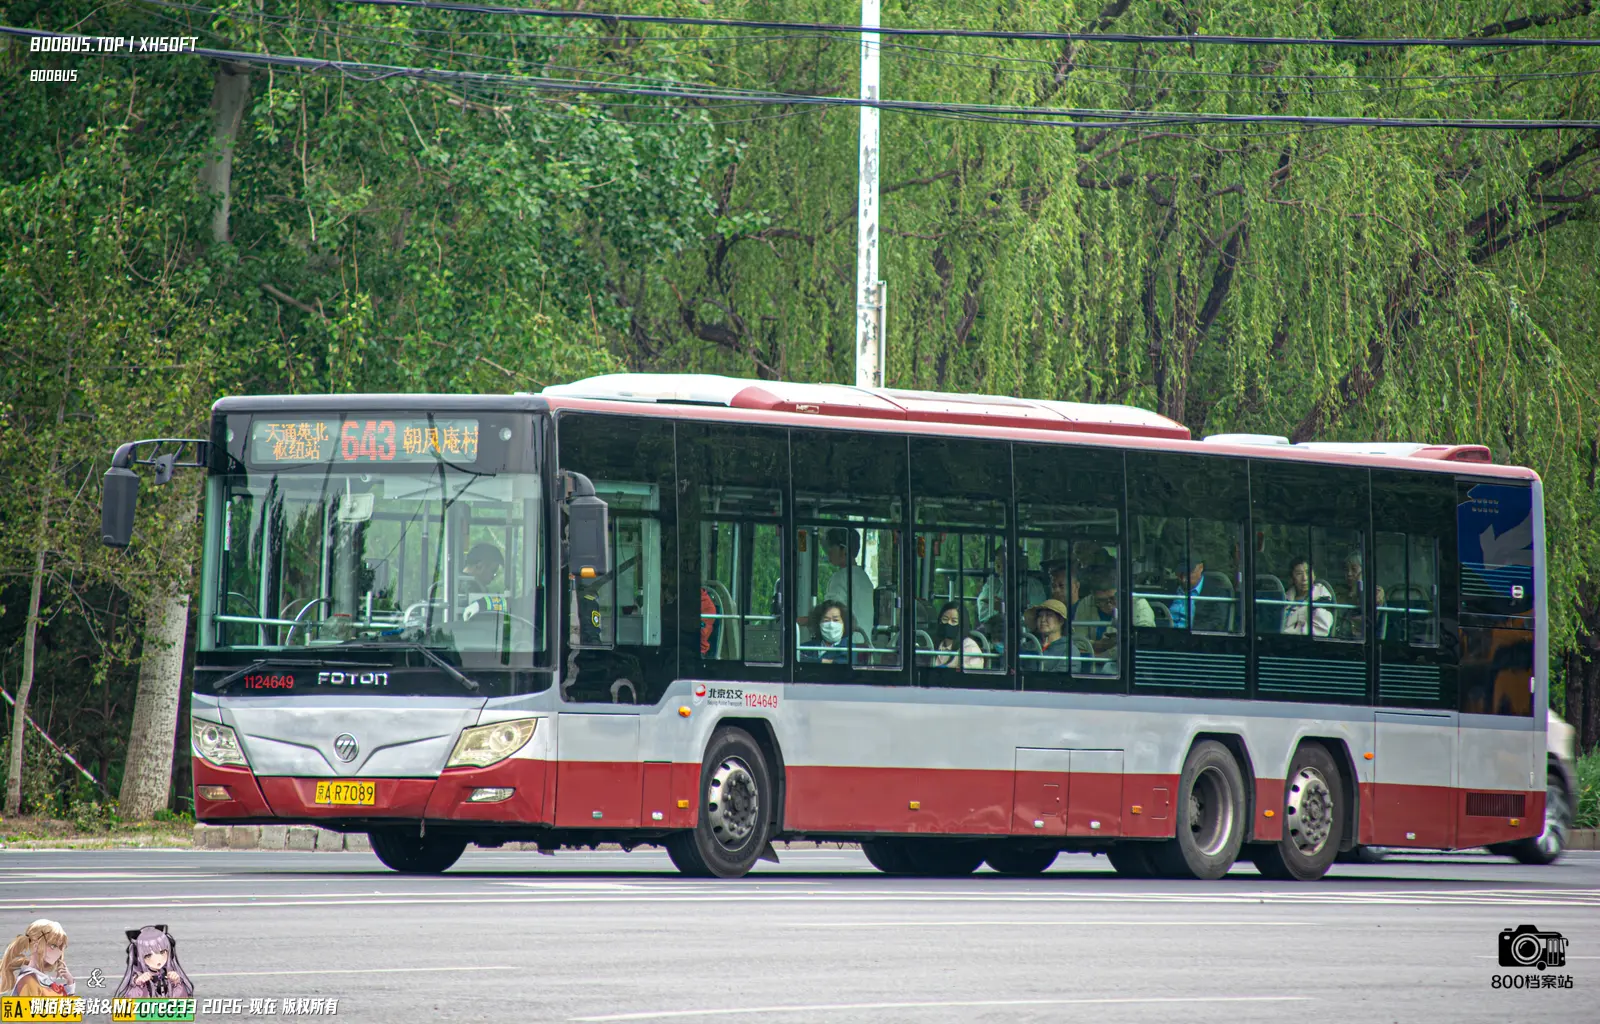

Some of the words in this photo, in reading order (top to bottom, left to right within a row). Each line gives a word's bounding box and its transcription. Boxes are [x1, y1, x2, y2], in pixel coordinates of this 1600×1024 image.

[341, 420, 397, 461] 643
[244, 675, 294, 689] 1124649
[317, 672, 388, 686] FOTON
[708, 688, 743, 699] 北京公交
[745, 694, 778, 708] 1124649
